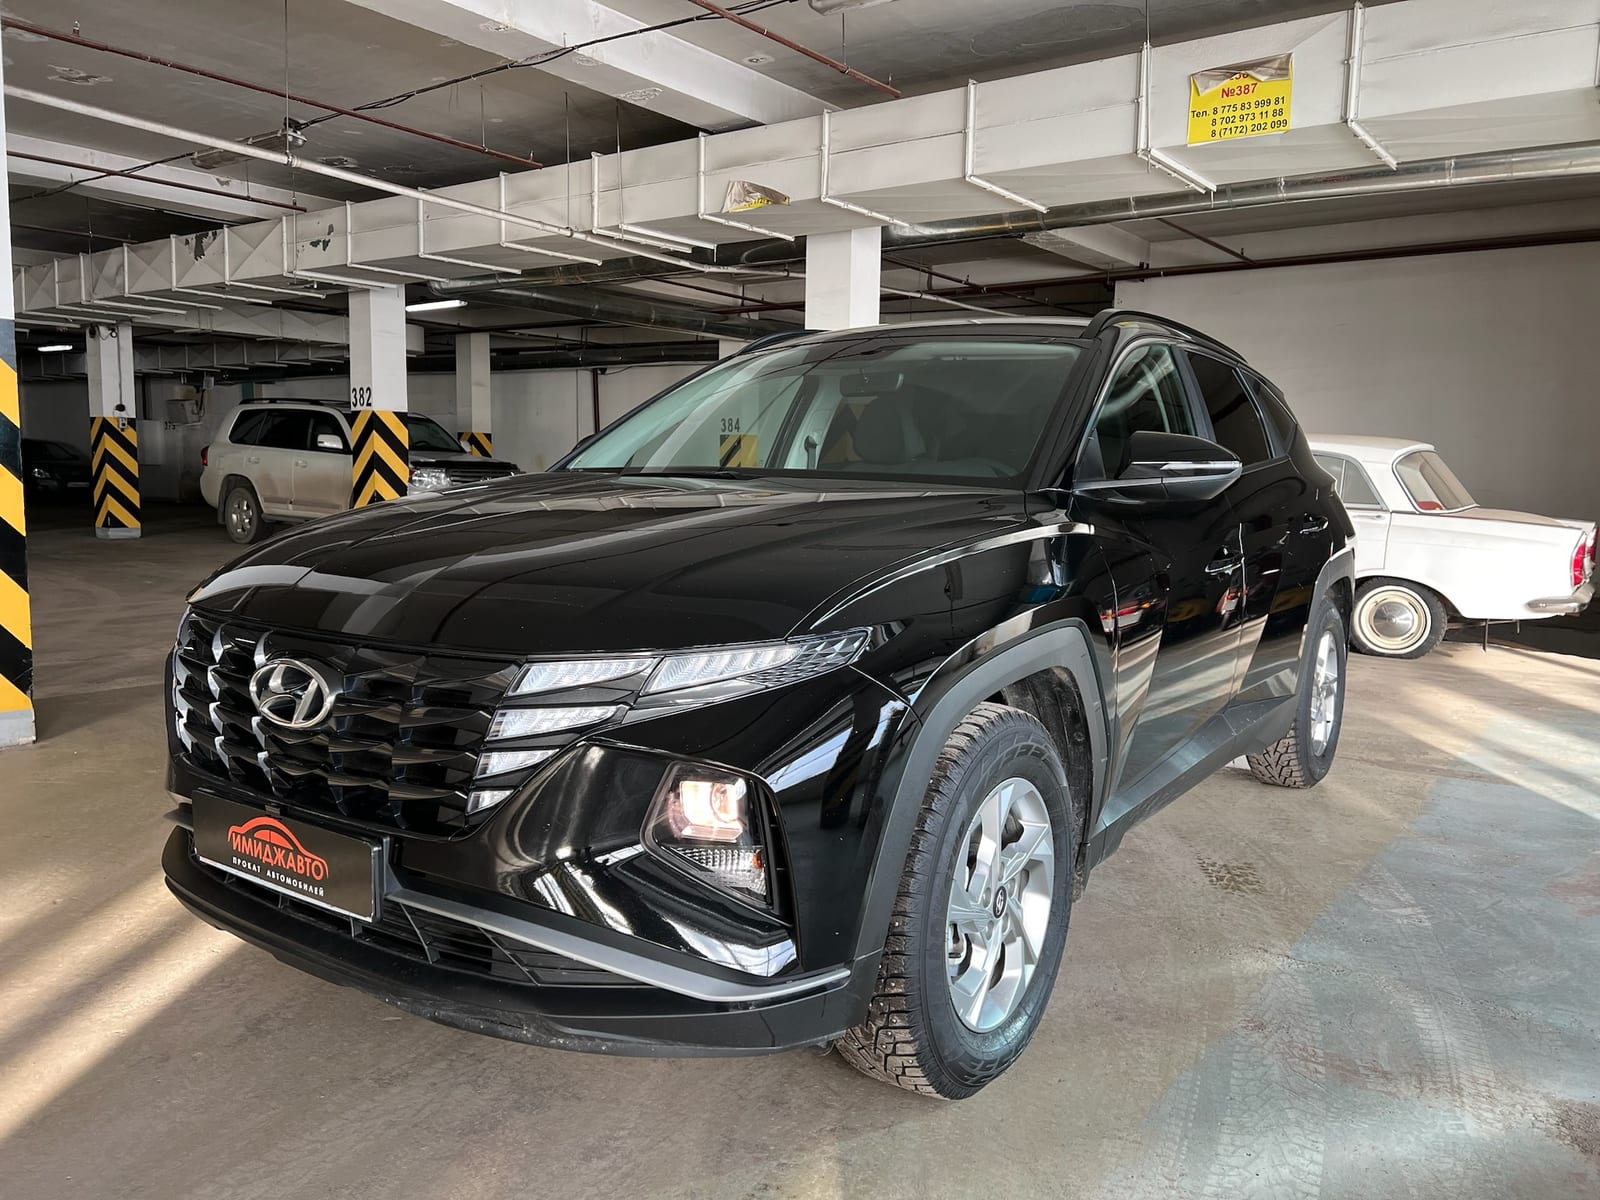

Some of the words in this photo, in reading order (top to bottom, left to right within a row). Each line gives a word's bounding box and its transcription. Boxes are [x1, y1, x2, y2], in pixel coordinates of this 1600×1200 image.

[1221, 82, 1258, 98] №387
[1191, 109, 1210, 118] Тел.
[1212, 106, 1218, 115] 8
[1221, 103, 1238, 114] 775
[1240, 101, 1252, 111] 83
[1254, 98, 1271, 108] 999
[1274, 96, 1285, 105] 81
[1211, 118, 1217, 126] 8
[1220, 115, 1236, 125] 702
[1239, 112, 1256, 122] 973
[1259, 111, 1269, 119] 11
[1271, 108, 1284, 117] 88
[1210, 129, 1217, 138] 8
[1219, 125, 1248, 137] (7172)
[1251, 121, 1267, 132] 202
[1270, 118, 1287, 129] 099
[352, 386, 372, 408] 382
[720, 417, 740, 433] 384
[232, 832, 324, 881] ИМИДЖАВТО
[232, 856, 261, 873] ПРОКАТ
[266, 869, 324, 897] АВТОМОБИЛЕЙ
